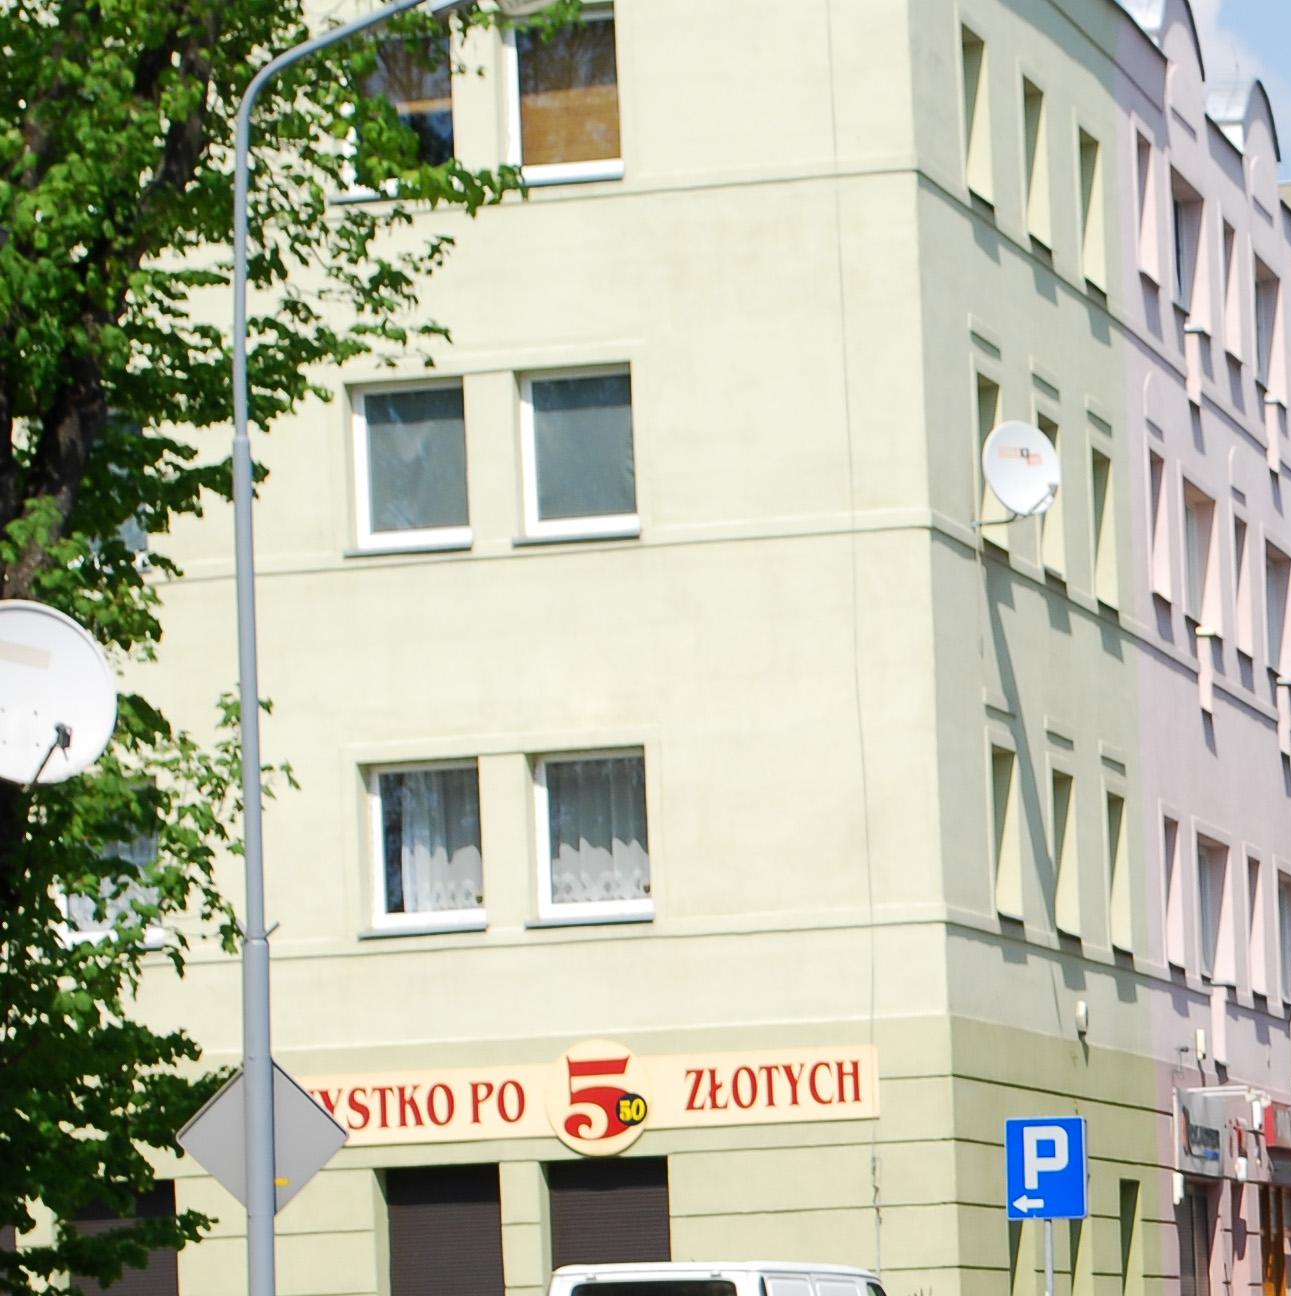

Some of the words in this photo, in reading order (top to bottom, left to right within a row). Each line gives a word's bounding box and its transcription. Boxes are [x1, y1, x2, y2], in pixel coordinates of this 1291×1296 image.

[309, 1083, 455, 1130] YSTKO
[469, 1080, 525, 1124] PO
[564, 1055, 640, 1140] 5
[684, 1059, 862, 1112] ZŁOTYCH
[620, 1097, 646, 1122] 50
[1023, 1125, 1069, 1190] P
